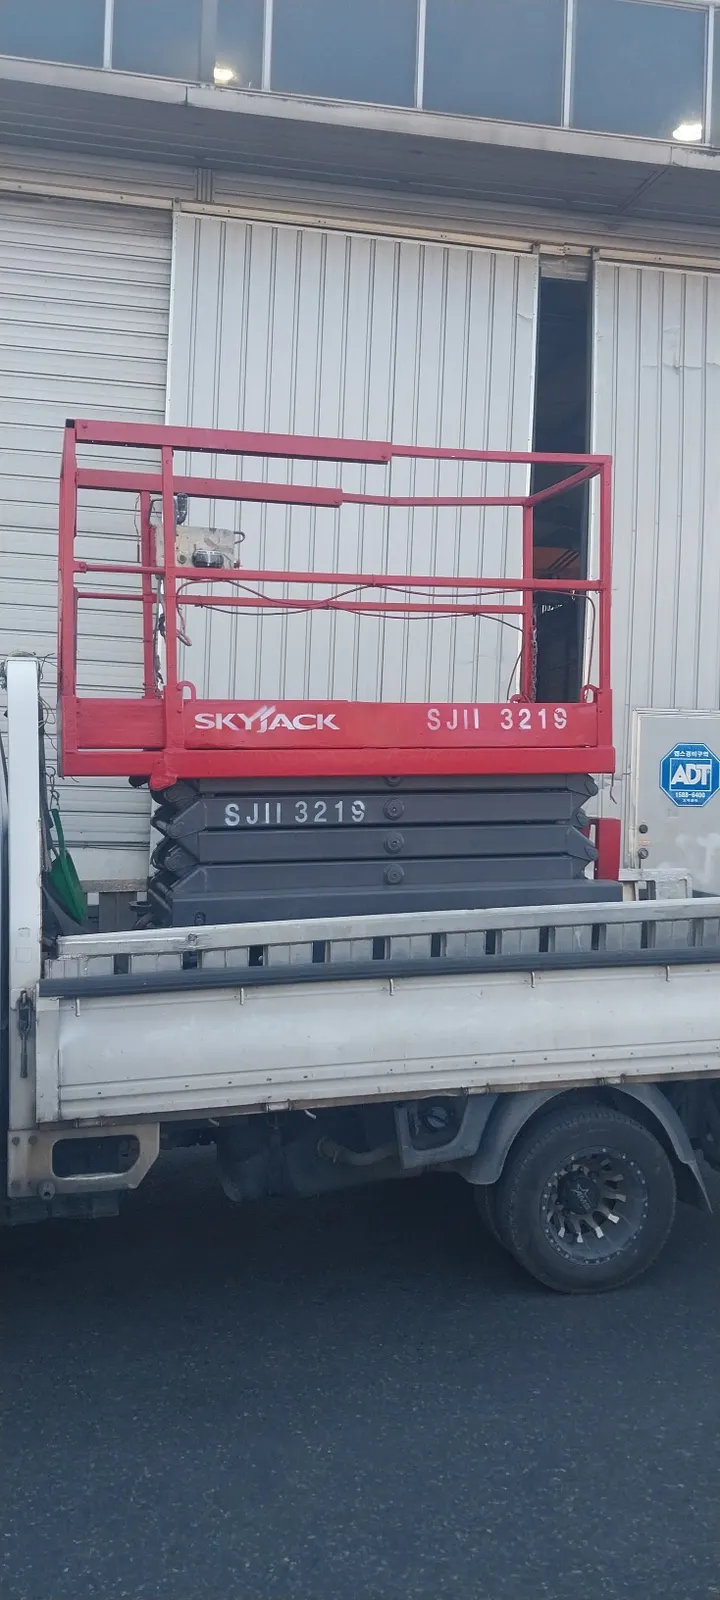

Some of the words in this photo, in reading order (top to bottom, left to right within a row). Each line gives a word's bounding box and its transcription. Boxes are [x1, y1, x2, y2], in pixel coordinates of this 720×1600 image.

[194, 705, 340, 733] SKYJACK
[500, 707, 567, 730] 3219
[670, 764, 711, 785] ADT
[295, 800, 366, 823] 3219
